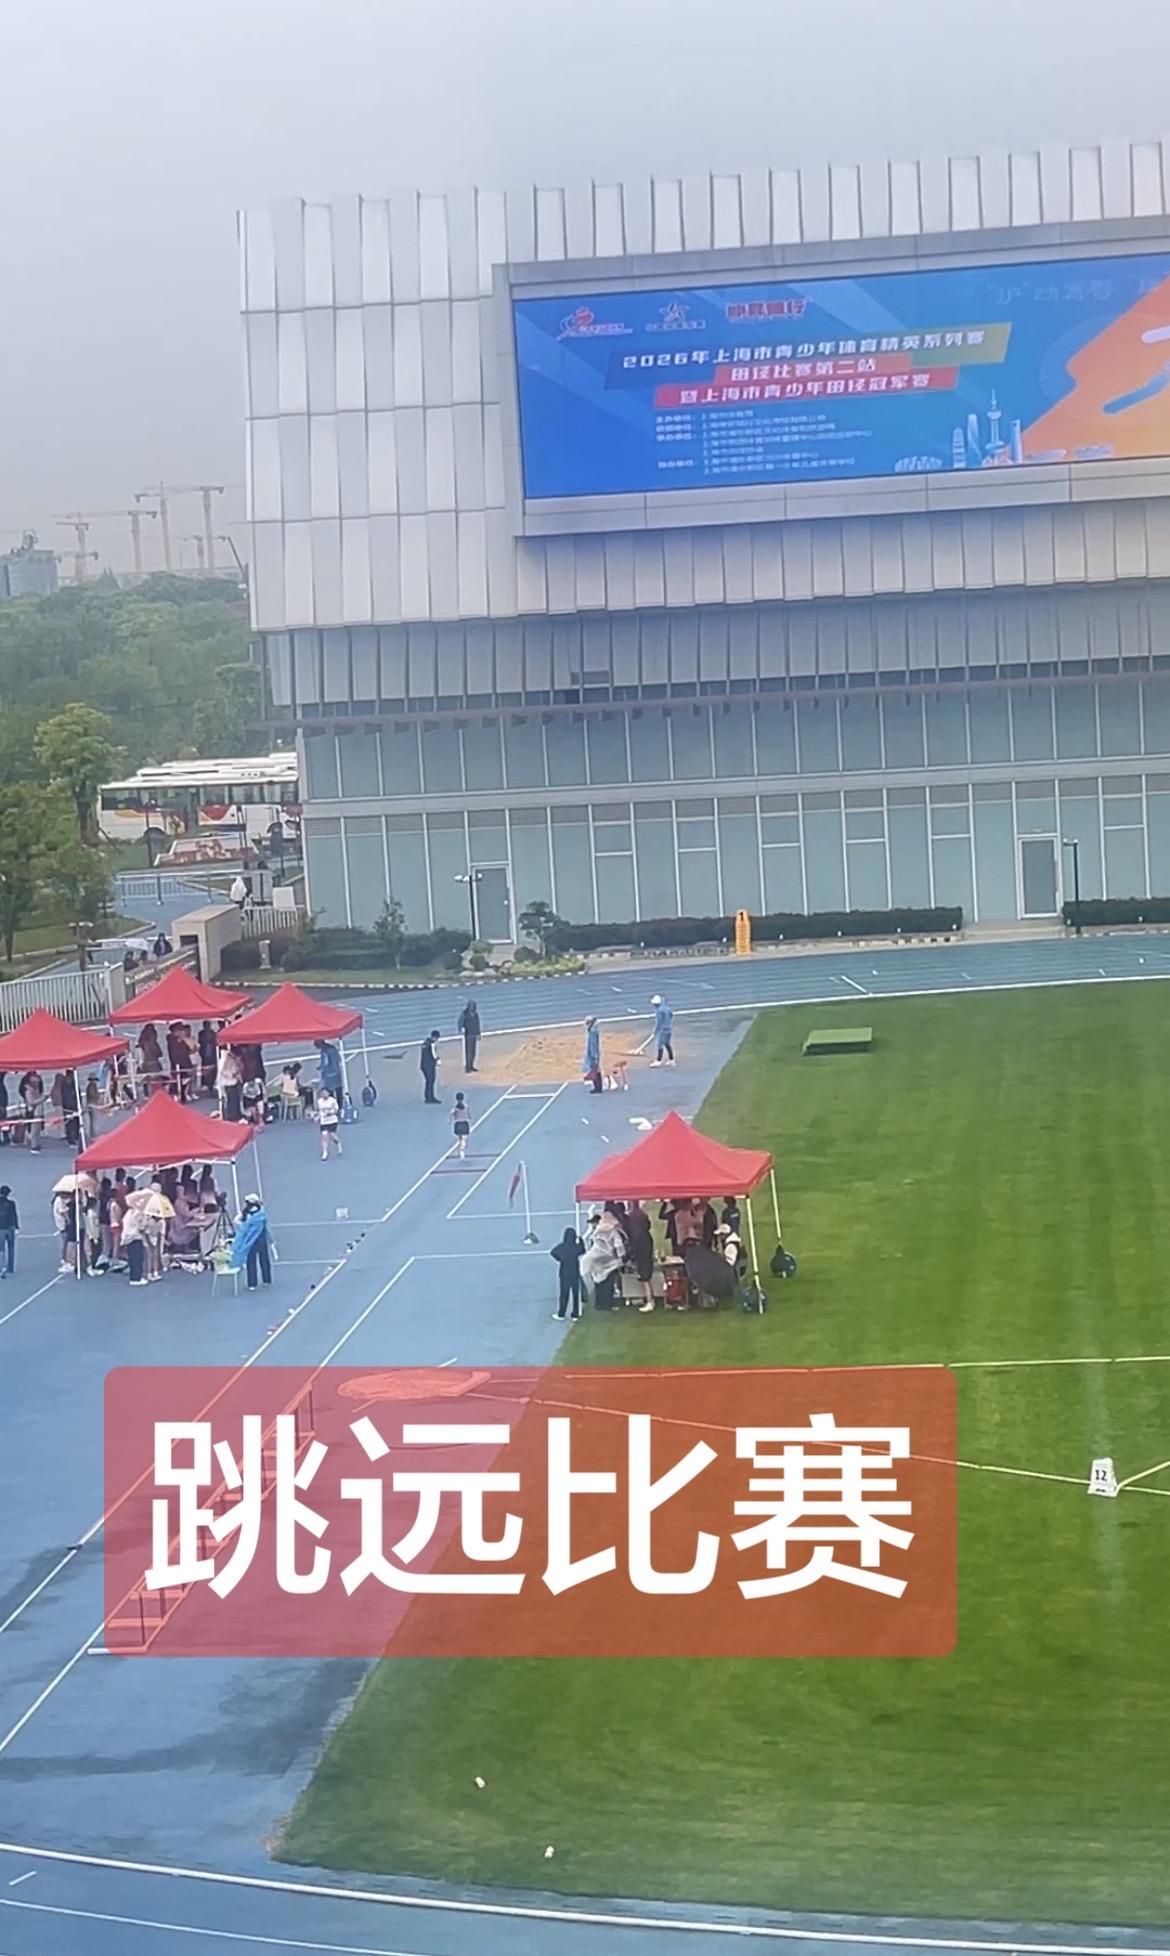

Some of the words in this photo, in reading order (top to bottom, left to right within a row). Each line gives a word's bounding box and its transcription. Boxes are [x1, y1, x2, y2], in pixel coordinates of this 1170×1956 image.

[623, 331, 985, 368] 2026年上海市青少年体育精英系列赛
[731, 358, 877, 383] 田径比赛第二站
[680, 373, 931, 405] 暨上海市青少年田径冠军赛
[1095, 1469, 1107, 1481] 12
